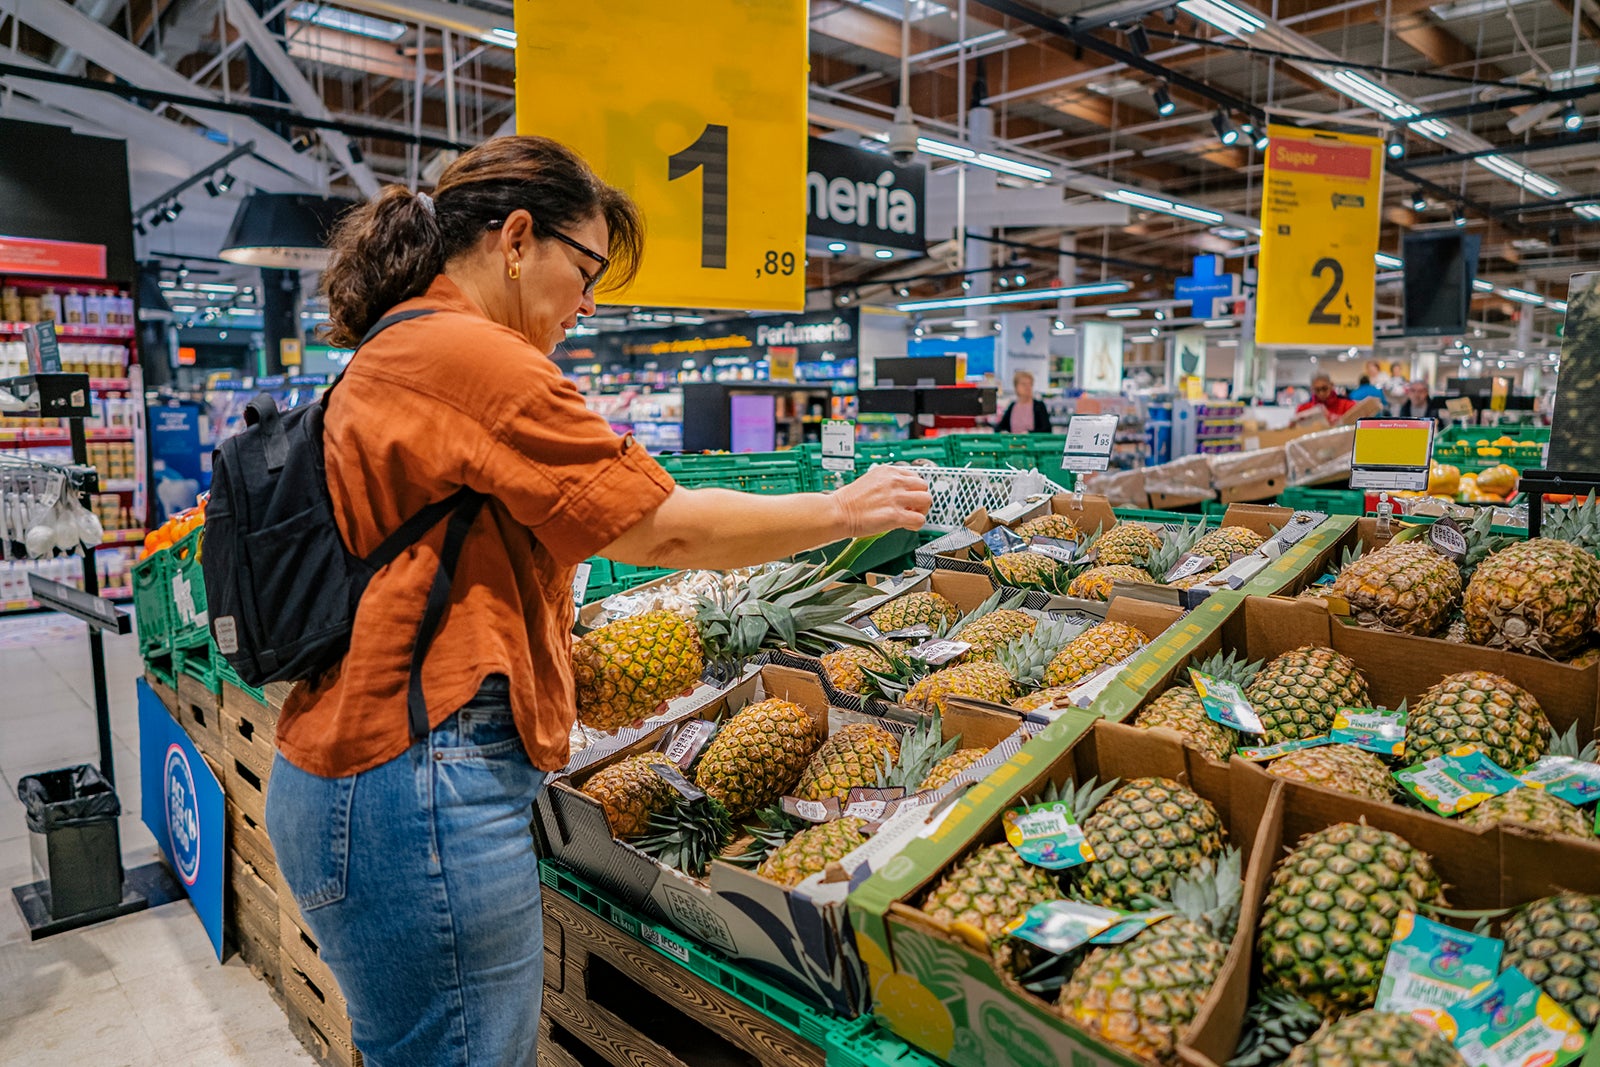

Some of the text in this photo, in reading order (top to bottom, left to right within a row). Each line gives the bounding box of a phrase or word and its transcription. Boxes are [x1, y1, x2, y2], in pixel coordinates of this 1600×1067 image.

[668, 124, 728, 270] 1
[755, 250, 796, 278] ,89
[1308, 257, 1344, 325] 2
[1093, 433, 1099, 446] 1
[1434, 532, 1465, 550] RESERVE
[670, 724, 694, 758] RESERVE
[670, 891, 723, 929] SPECIAL
[674, 902, 728, 941] RESERVE
